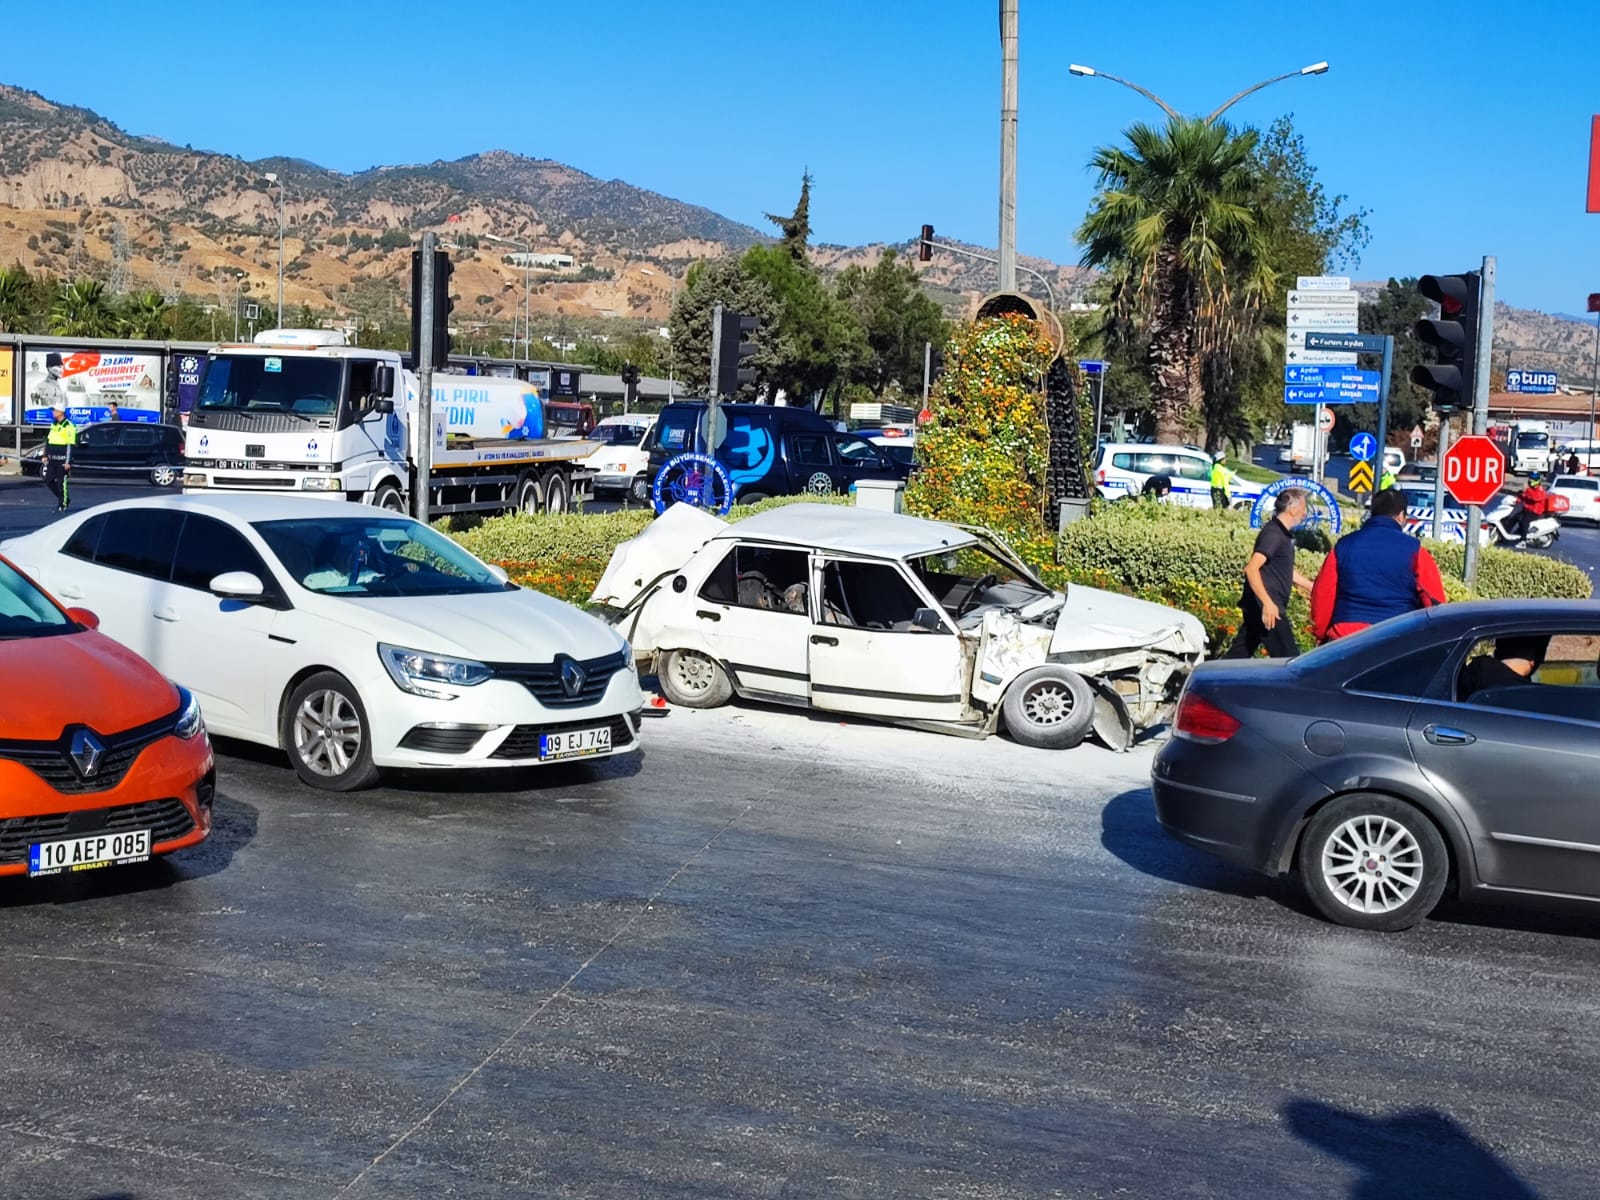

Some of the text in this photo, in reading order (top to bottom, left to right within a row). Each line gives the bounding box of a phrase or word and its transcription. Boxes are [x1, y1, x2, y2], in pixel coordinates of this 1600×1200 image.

[113, 356, 133, 365] EKİM
[89, 364, 145, 377] CUMHURİYET
[1522, 372, 1557, 385] tuna
[1447, 456, 1499, 483] DUR
[547, 729, 609, 752] 09 EJ 742
[45, 844, 66, 866] 10
[73, 839, 106, 863] AEP
[112, 833, 145, 857] 085
[72, 861, 109, 872] ERMAT
